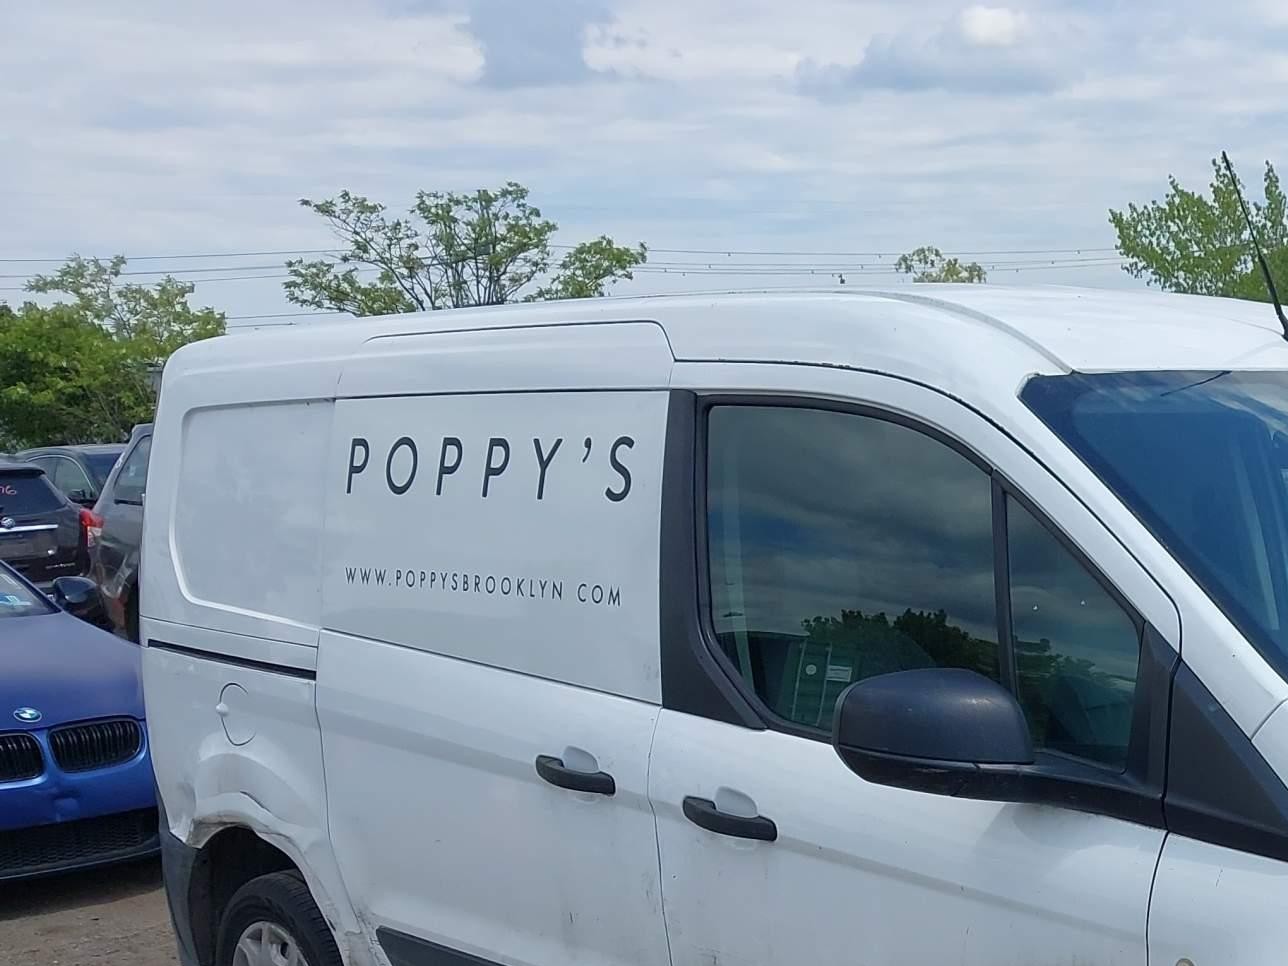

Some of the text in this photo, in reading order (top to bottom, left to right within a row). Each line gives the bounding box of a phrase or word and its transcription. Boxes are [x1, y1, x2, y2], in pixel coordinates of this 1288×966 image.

[347, 437, 634, 501] POPPY'S
[346, 568, 620, 606] WWW.POPPYSBROOKLYN COM
